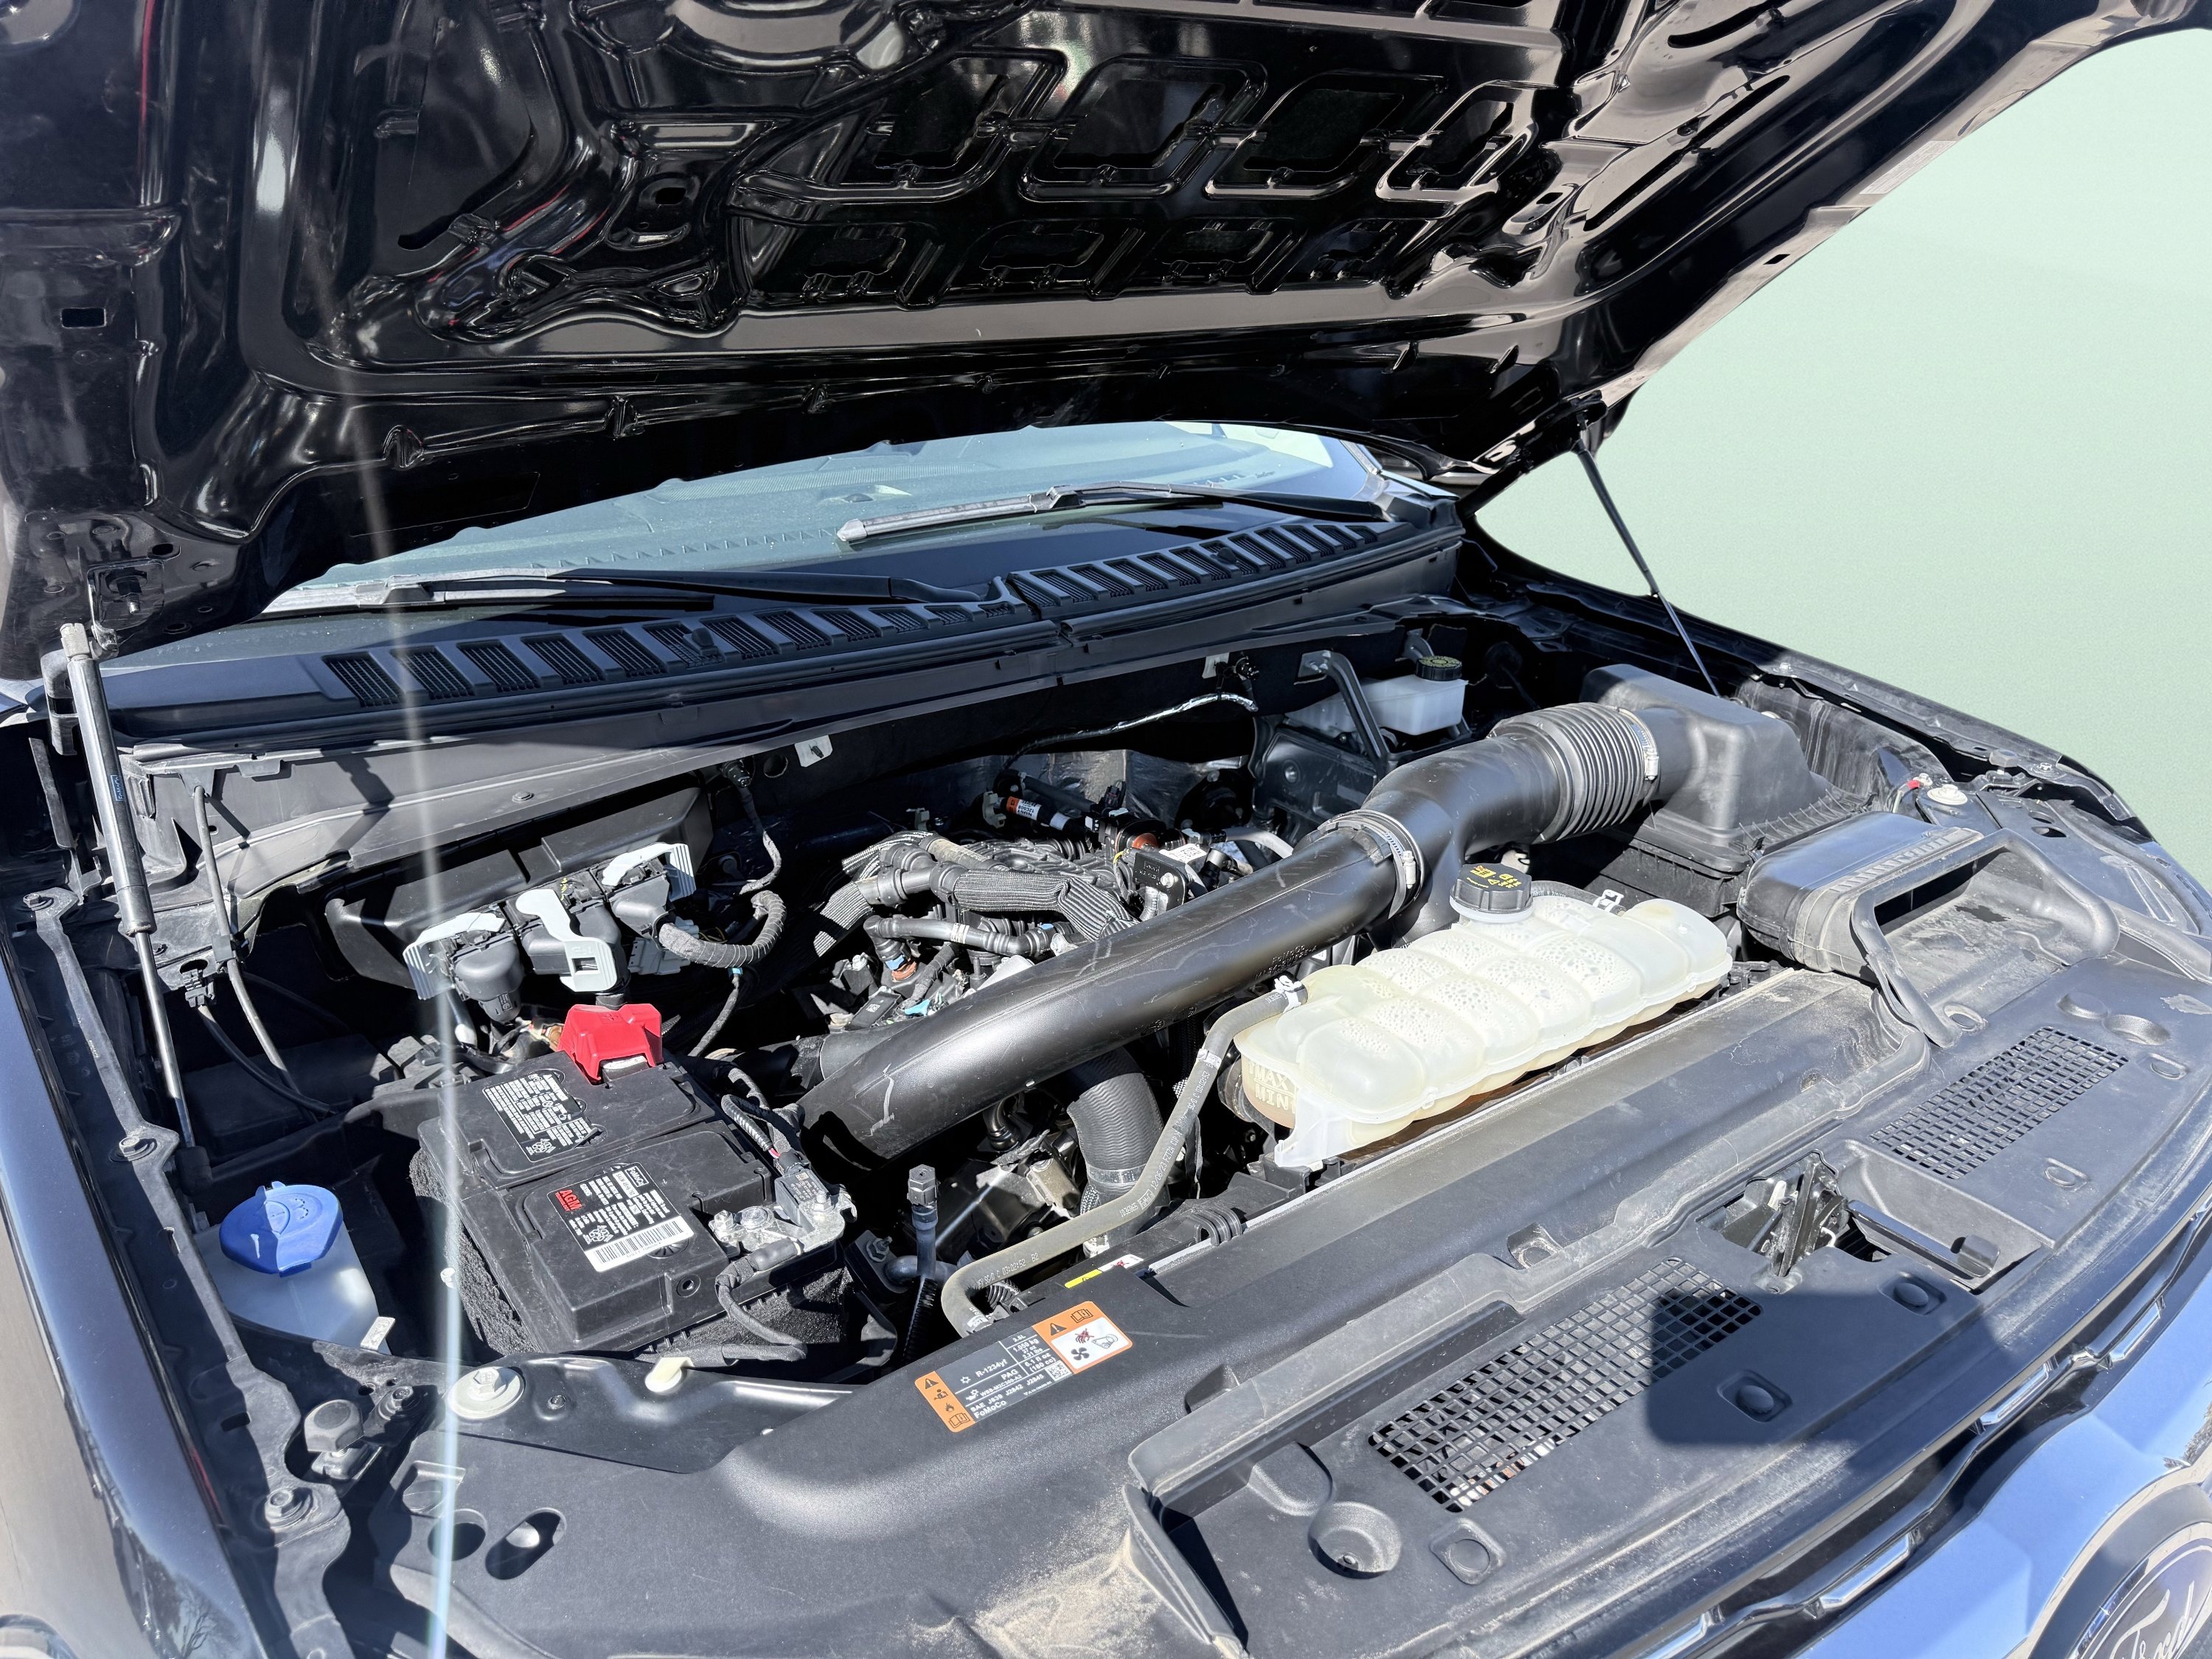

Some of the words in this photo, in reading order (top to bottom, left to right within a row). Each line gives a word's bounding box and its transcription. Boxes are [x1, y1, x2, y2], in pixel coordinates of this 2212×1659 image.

[1254, 1063, 1289, 1091] MAX
[1255, 1082, 1289, 1110] MIN
[626, 1167, 646, 1186] FoMoCo
[560, 1189, 582, 1211] AGM
[1012, 1341, 1030, 1352] 1.050
[975, 1358, 1009, 1377] R-1234yf
[1024, 1359, 1036, 1367] 6.1
[1029, 1361, 1046, 1372] (180
[1043, 1356, 1057, 1365] cc)
[1001, 1368, 1018, 1380] PAG
[970, 1402, 986, 1412] SAE
[1004, 1383, 1023, 1395] J2842
[973, 1399, 1007, 1419] FoMoCo
